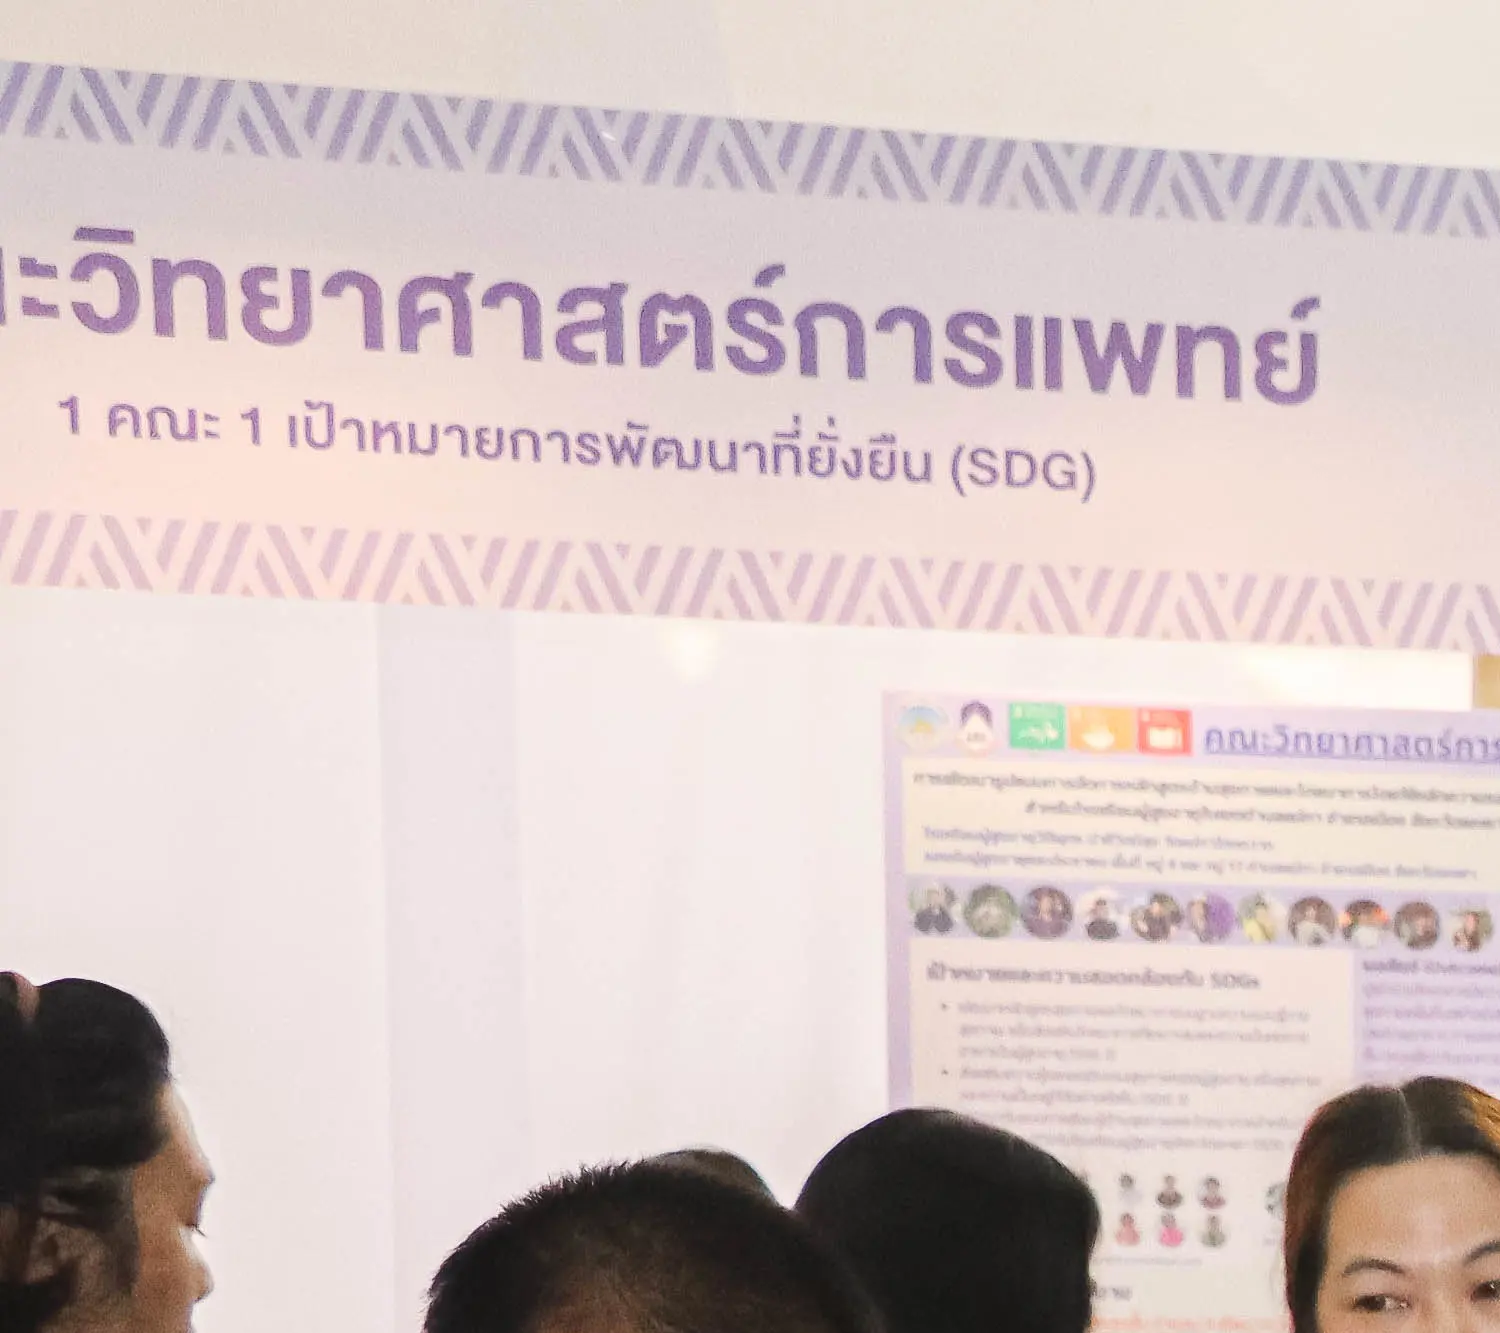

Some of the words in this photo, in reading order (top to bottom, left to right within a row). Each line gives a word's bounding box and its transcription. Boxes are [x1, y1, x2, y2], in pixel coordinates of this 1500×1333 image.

[0, 226, 1322, 408] ะวิทยาศาสตร์การแพทย์
[58, 396, 82, 437] 1
[106, 400, 222, 441] คณะ
[239, 408, 263, 448] 1
[286, 400, 933, 486] เป้าหมายการพัฒนาที่ยั่งยืน
[948, 444, 1097, 504] (SDG)
